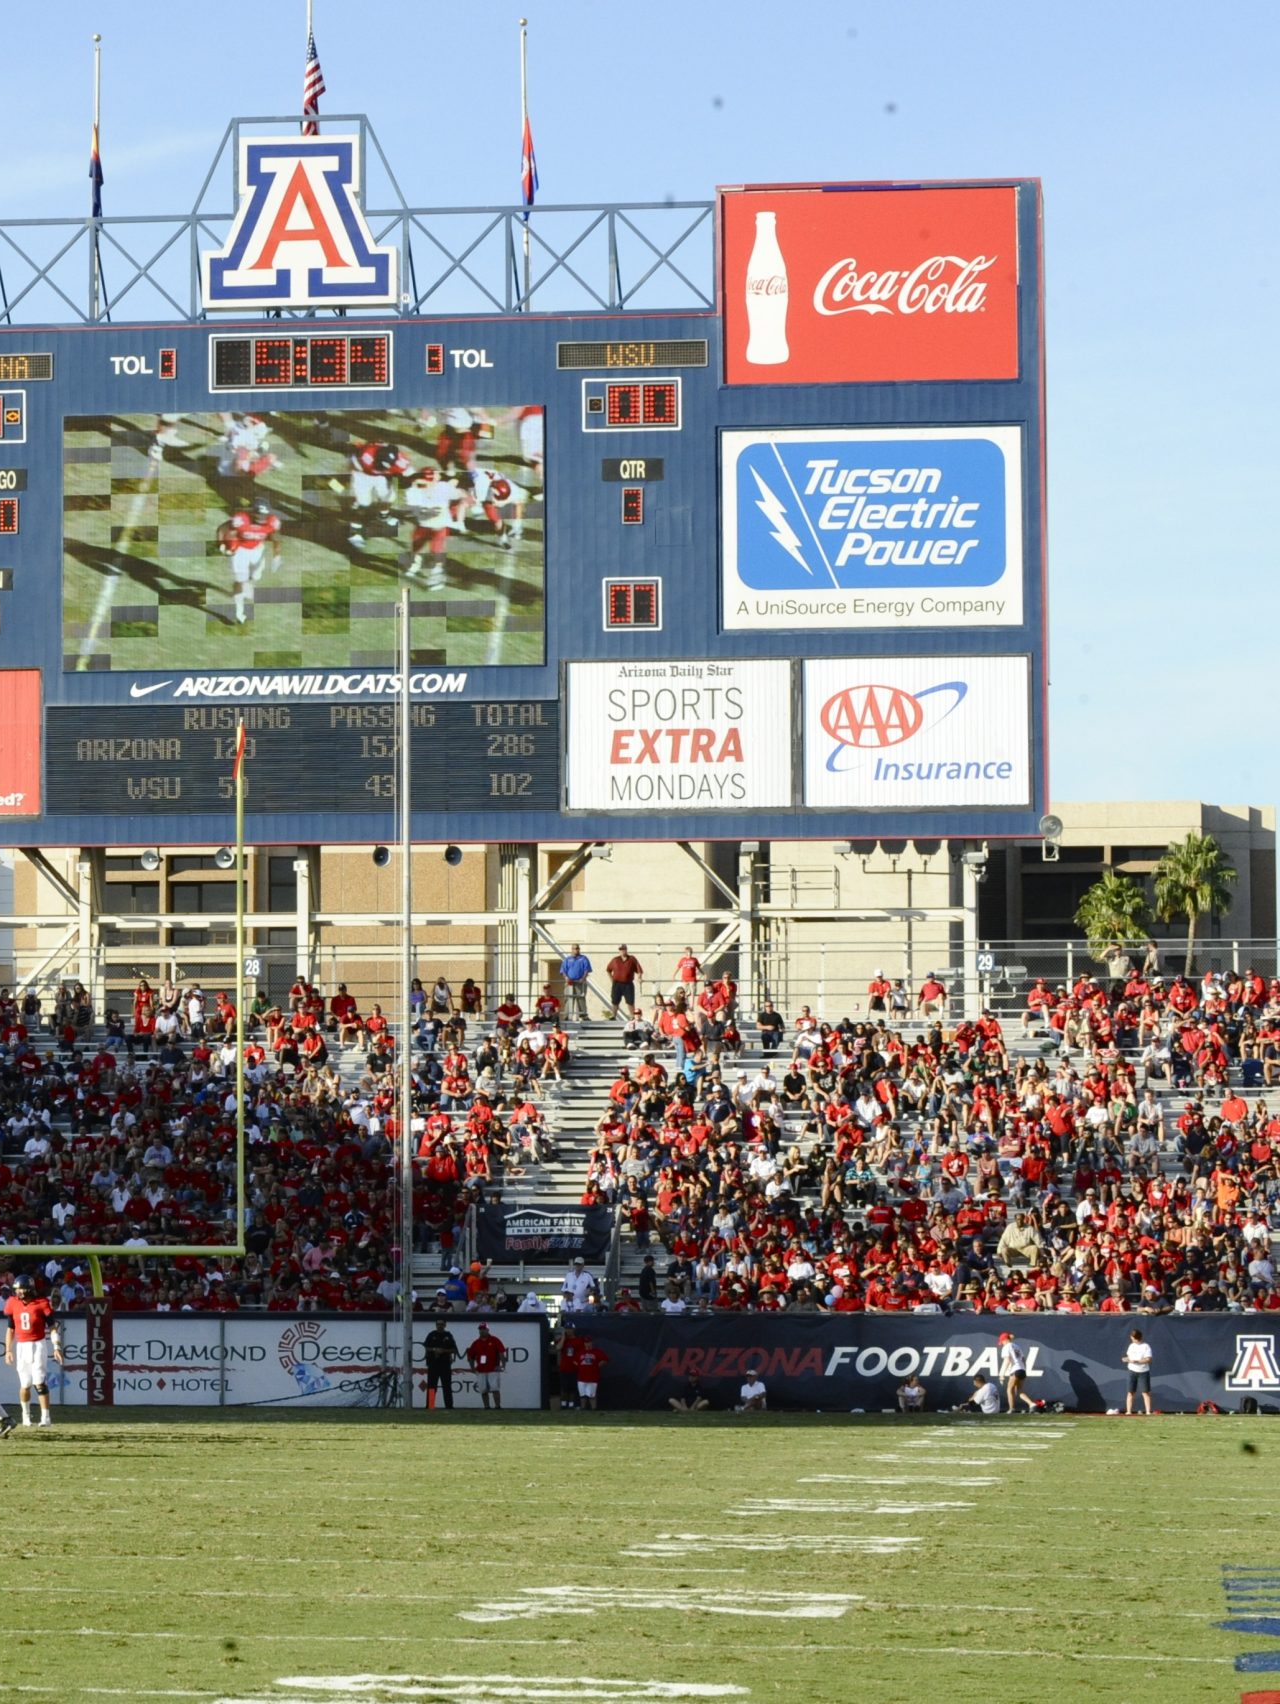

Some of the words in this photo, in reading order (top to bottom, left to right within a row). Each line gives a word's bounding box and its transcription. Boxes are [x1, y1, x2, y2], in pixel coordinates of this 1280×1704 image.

[210, 143, 389, 300] A
[813, 254, 999, 316] Coca-Cola
[110, 356, 153, 375] TOL
[161, 350, 176, 378] 3
[255, 339, 387, 384] 5:34
[428, 345, 443, 373] 3
[450, 350, 493, 368] TOL
[605, 344, 656, 367] WSU
[607, 384, 677, 424] 00
[620, 460, 645, 478] QTR
[805, 459, 942, 494] Tucson
[624, 488, 641, 521] 3
[818, 495, 980, 530] Electric
[834, 533, 979, 567] Power
[737, 601, 749, 614] A
[755, 599, 846, 615] UniSource
[853, 598, 915, 617] Energy
[920, 597, 1006, 616] Company
[618, 665, 667, 678] Arizona
[669, 664, 703, 680] Daily
[706, 664, 734, 678] Star
[184, 707, 291, 729] RUSHING
[472, 704, 549, 727] TOTAL
[607, 687, 744, 722] SPORTS
[826, 686, 917, 748] AAA
[77, 739, 181, 761] ARIZONA
[487, 735, 535, 757] 286
[610, 727, 744, 765] EXTRA
[874, 757, 1013, 781] Insurance
[128, 777, 182, 800] WSU
[365, 775, 395, 797] 43
[489, 774, 532, 797] 102
[611, 773, 746, 802] MONDAYS
[245, 960, 261, 977] 28
[978, 955, 993, 972] 29
[506, 1218, 551, 1226] AMERICAN
[553, 1218, 585, 1226] FAMILY
[20, 1312, 31, 1331] 8
[88, 1303, 108, 1402] WILDCATS
[145, 1339, 267, 1362] DIAMOND
[650, 1347, 822, 1377] ARIZONA
[172, 1378, 233, 1392] HOTEL
